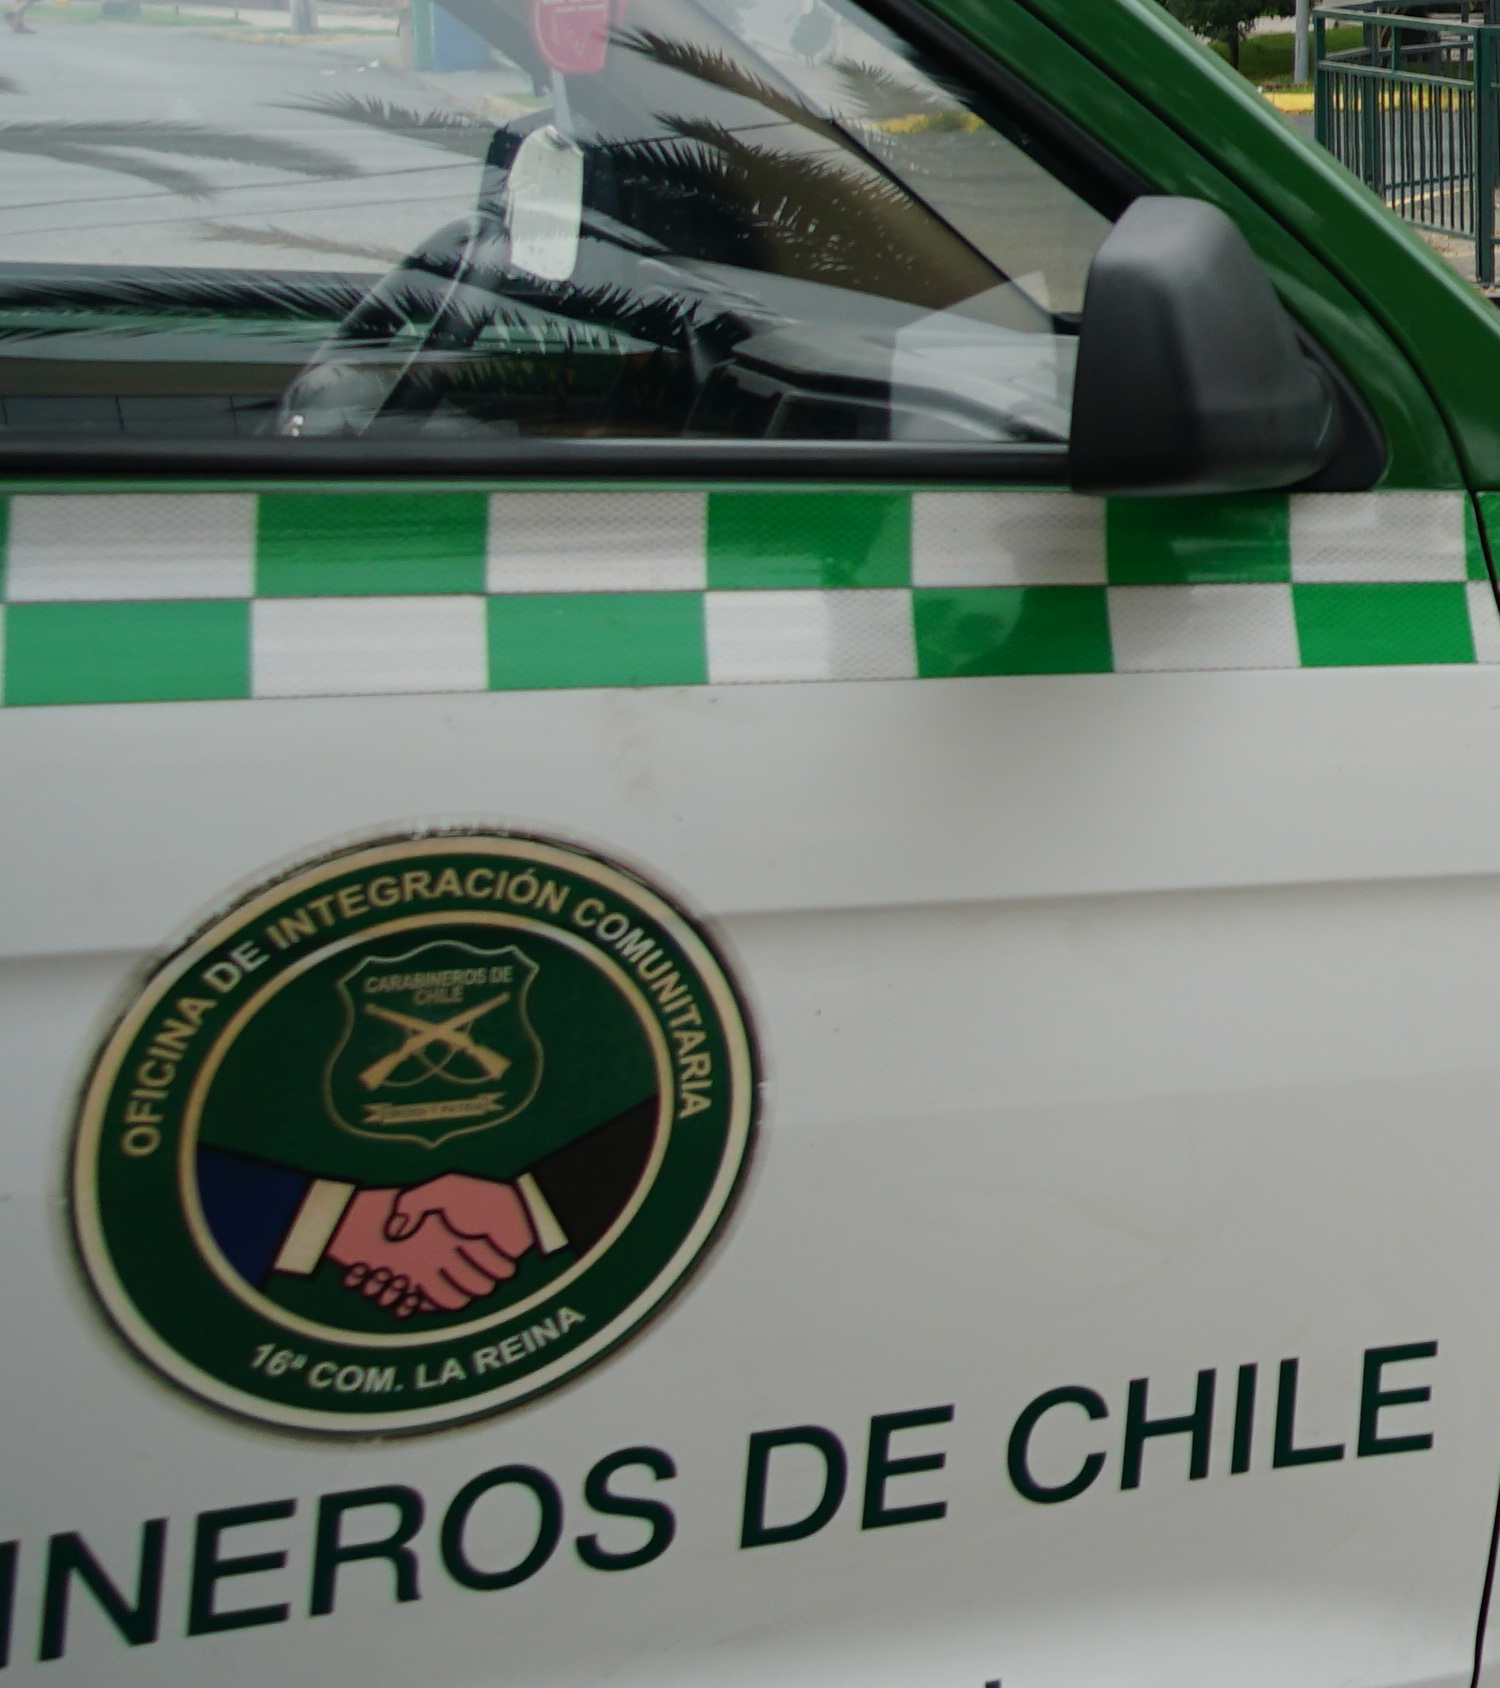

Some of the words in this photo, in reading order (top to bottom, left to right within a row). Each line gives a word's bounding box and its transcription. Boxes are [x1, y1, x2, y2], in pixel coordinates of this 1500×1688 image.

[121, 996, 218, 1157] OFICINA
[202, 939, 271, 994] DE
[265, 866, 571, 950] INTEGRACIÓN
[571, 897, 713, 1120] COMUNITARIA
[363, 968, 487, 993] CARABINEROS
[488, 965, 513, 984] DE
[412, 985, 464, 1006] CHILE
[307, 1360, 405, 1394] COM.
[415, 1357, 467, 1390] LA
[472, 1306, 586, 1376] REINA
[739, 1404, 955, 1550] DE
[1006, 1340, 1439, 1506] CHILE
